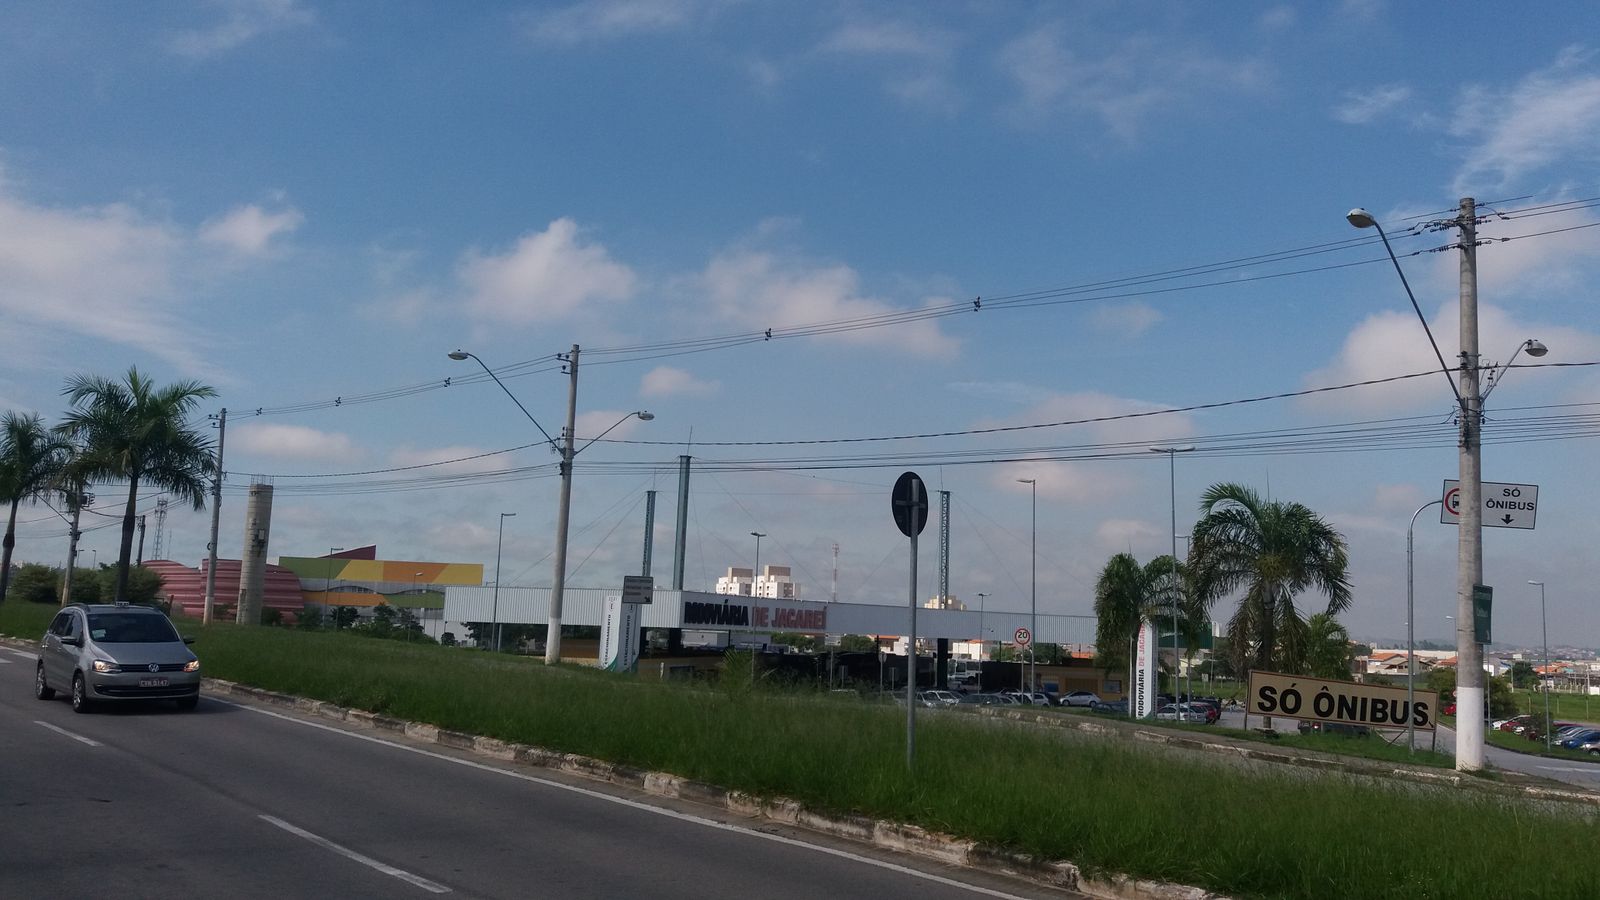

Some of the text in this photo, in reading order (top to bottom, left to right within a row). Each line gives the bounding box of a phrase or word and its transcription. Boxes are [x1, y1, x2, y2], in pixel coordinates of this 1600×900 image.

[1503, 487, 1521, 498] SÓ
[1485, 498, 1535, 511] ÔNIBUS
[752, 606, 769, 628] DE
[771, 605, 827, 630] JACAREÍ
[1018, 631, 1028, 639] 20
[1138, 656, 1145, 667] DE
[1137, 668, 1145, 717] RODOVIÁRIA
[1257, 683, 1429, 727] SÓ ÔNIBUS
